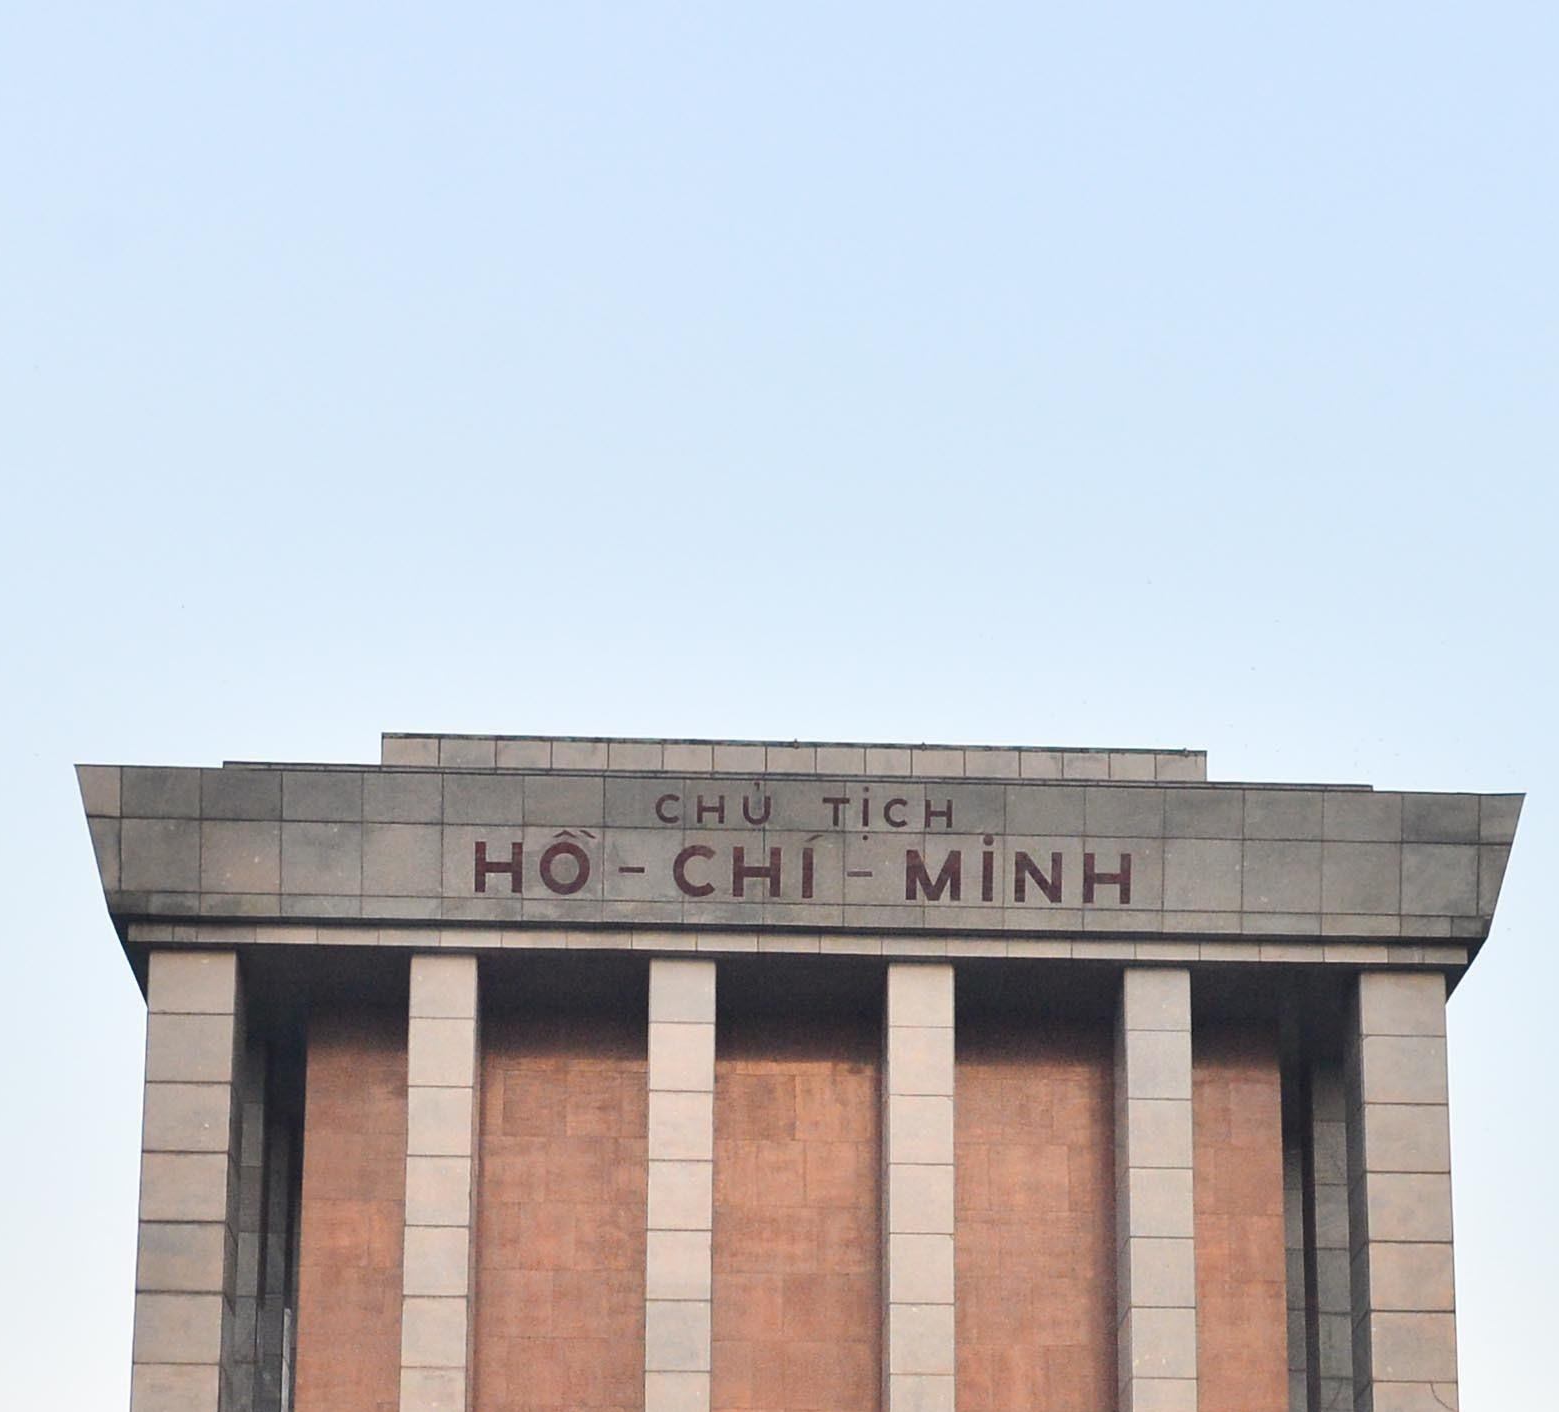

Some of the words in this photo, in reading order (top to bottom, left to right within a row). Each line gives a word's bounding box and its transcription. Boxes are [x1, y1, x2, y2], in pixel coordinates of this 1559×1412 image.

[655, 782, 772, 826] CHỦ
[822, 786, 954, 842] TỊCH
[474, 830, 597, 896] HỒ
[673, 834, 824, 899] CHÍ
